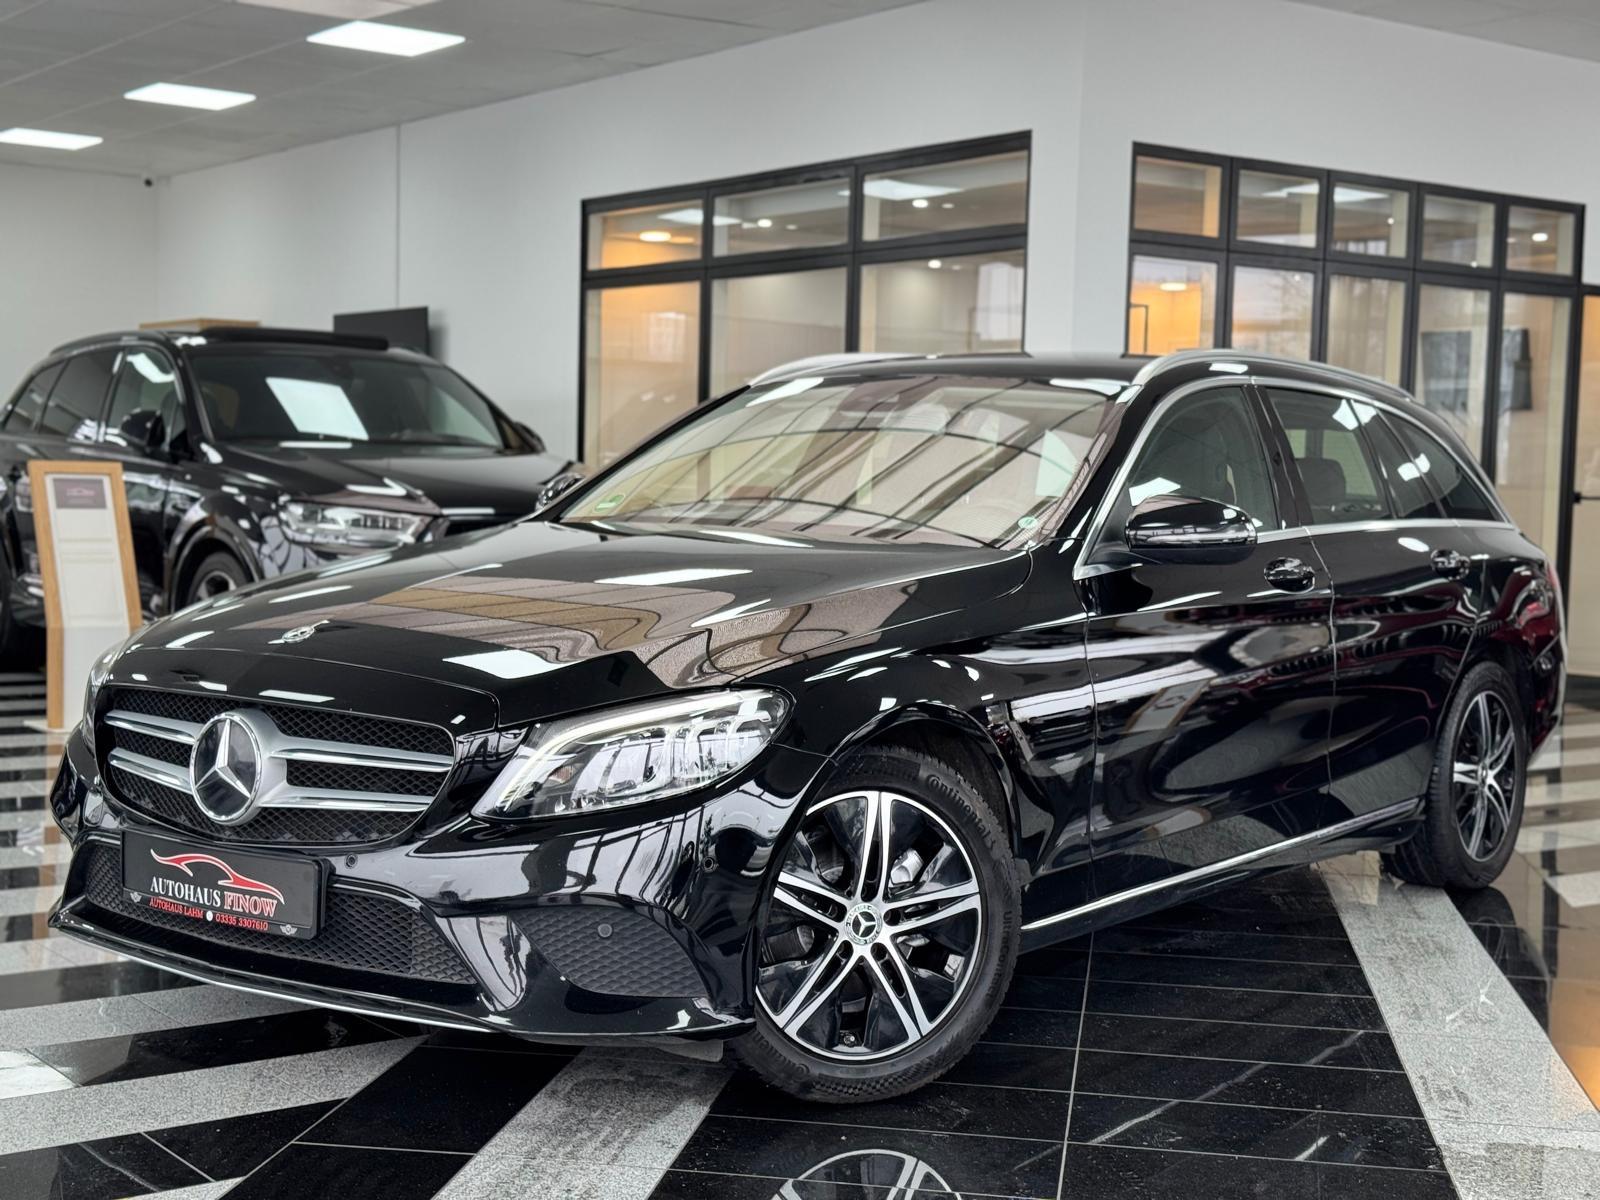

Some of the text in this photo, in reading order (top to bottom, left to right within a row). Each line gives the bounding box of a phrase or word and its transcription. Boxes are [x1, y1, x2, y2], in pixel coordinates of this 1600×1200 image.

[927, 774, 992, 839] Continental
[149, 897, 183, 914] AUTOHAUS
[184, 906, 204, 919] LAHM
[215, 913, 237, 926] 03335
[150, 876, 278, 917] AUTOHAUS FINOW
